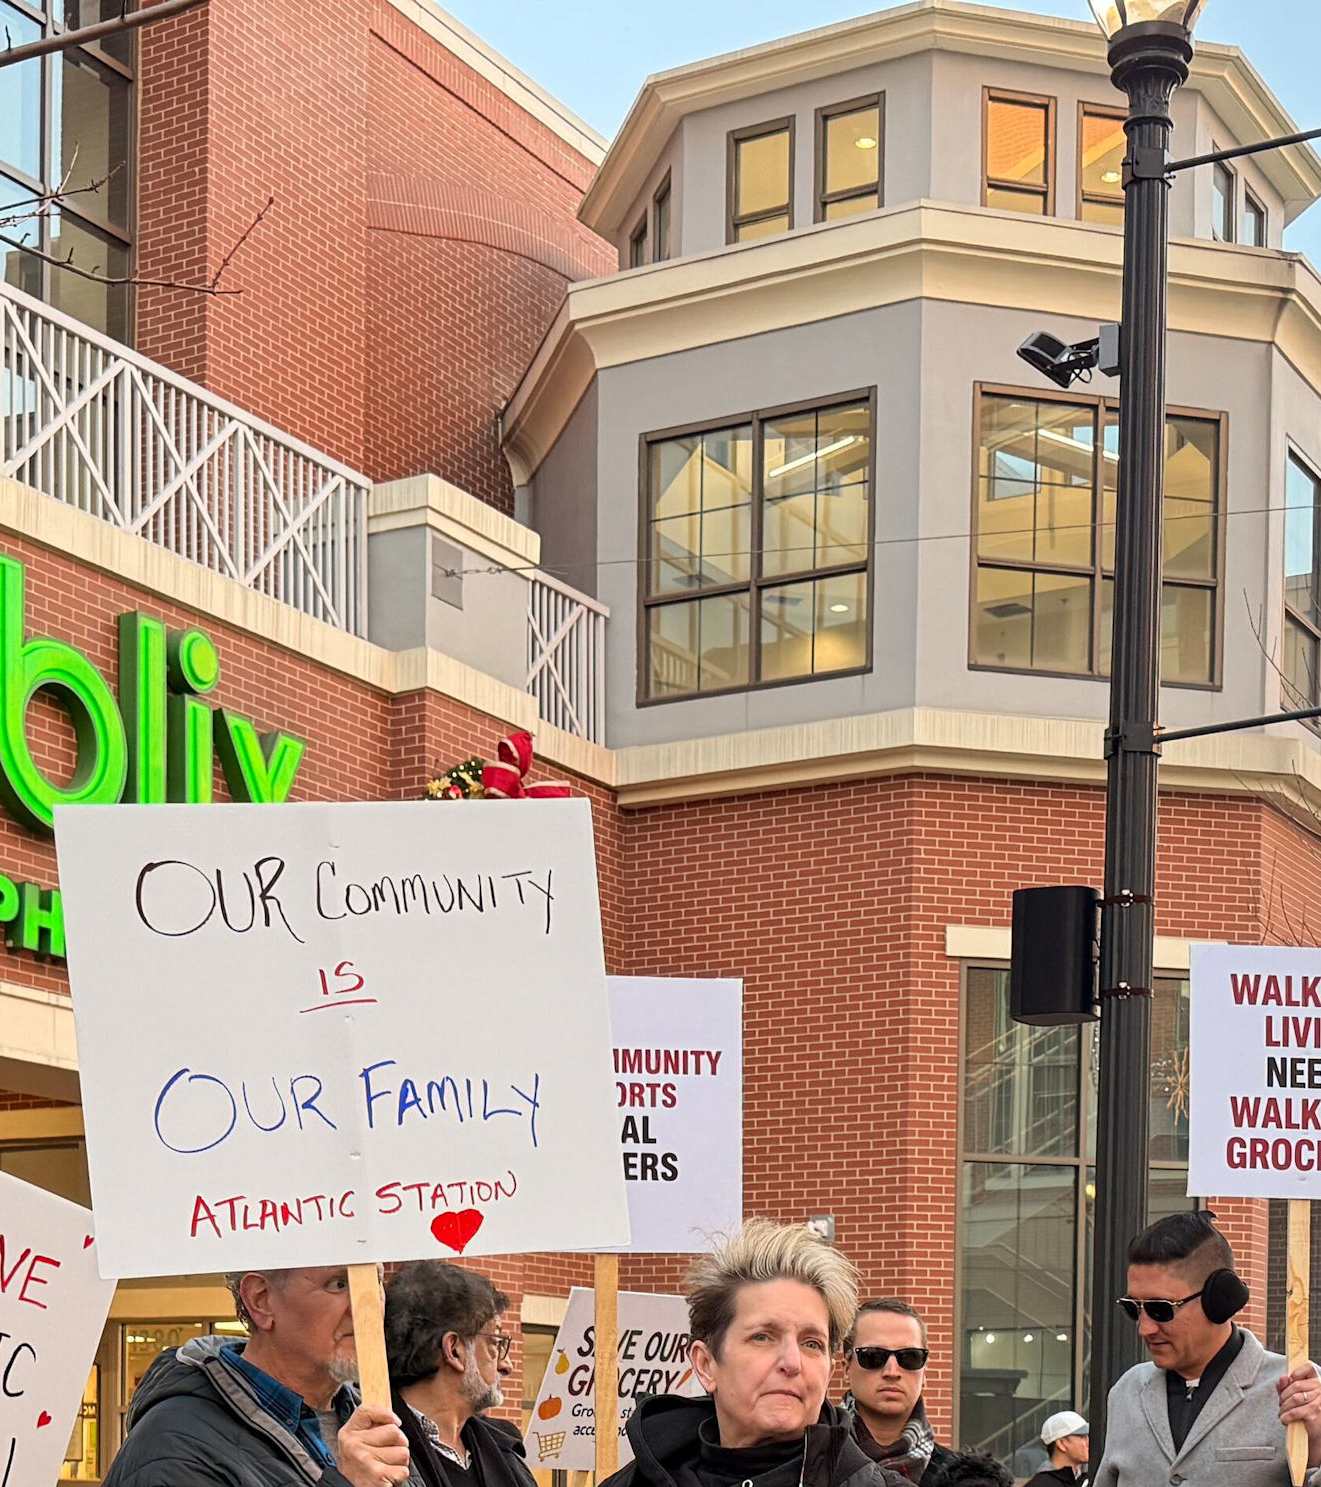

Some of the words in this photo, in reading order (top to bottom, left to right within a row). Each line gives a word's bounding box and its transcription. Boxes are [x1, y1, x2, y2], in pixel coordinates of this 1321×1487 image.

[136, 856, 304, 943] OUR
[318, 960, 364, 995] IS
[154, 1068, 337, 1153] OUR
[360, 1060, 539, 1147] FAMILY
[622, 1116, 657, 1144] AL
[623, 1152, 679, 1181] ERS
[190, 1190, 356, 1238] ATLANTIC
[375, 1170, 517, 1214] STATION
